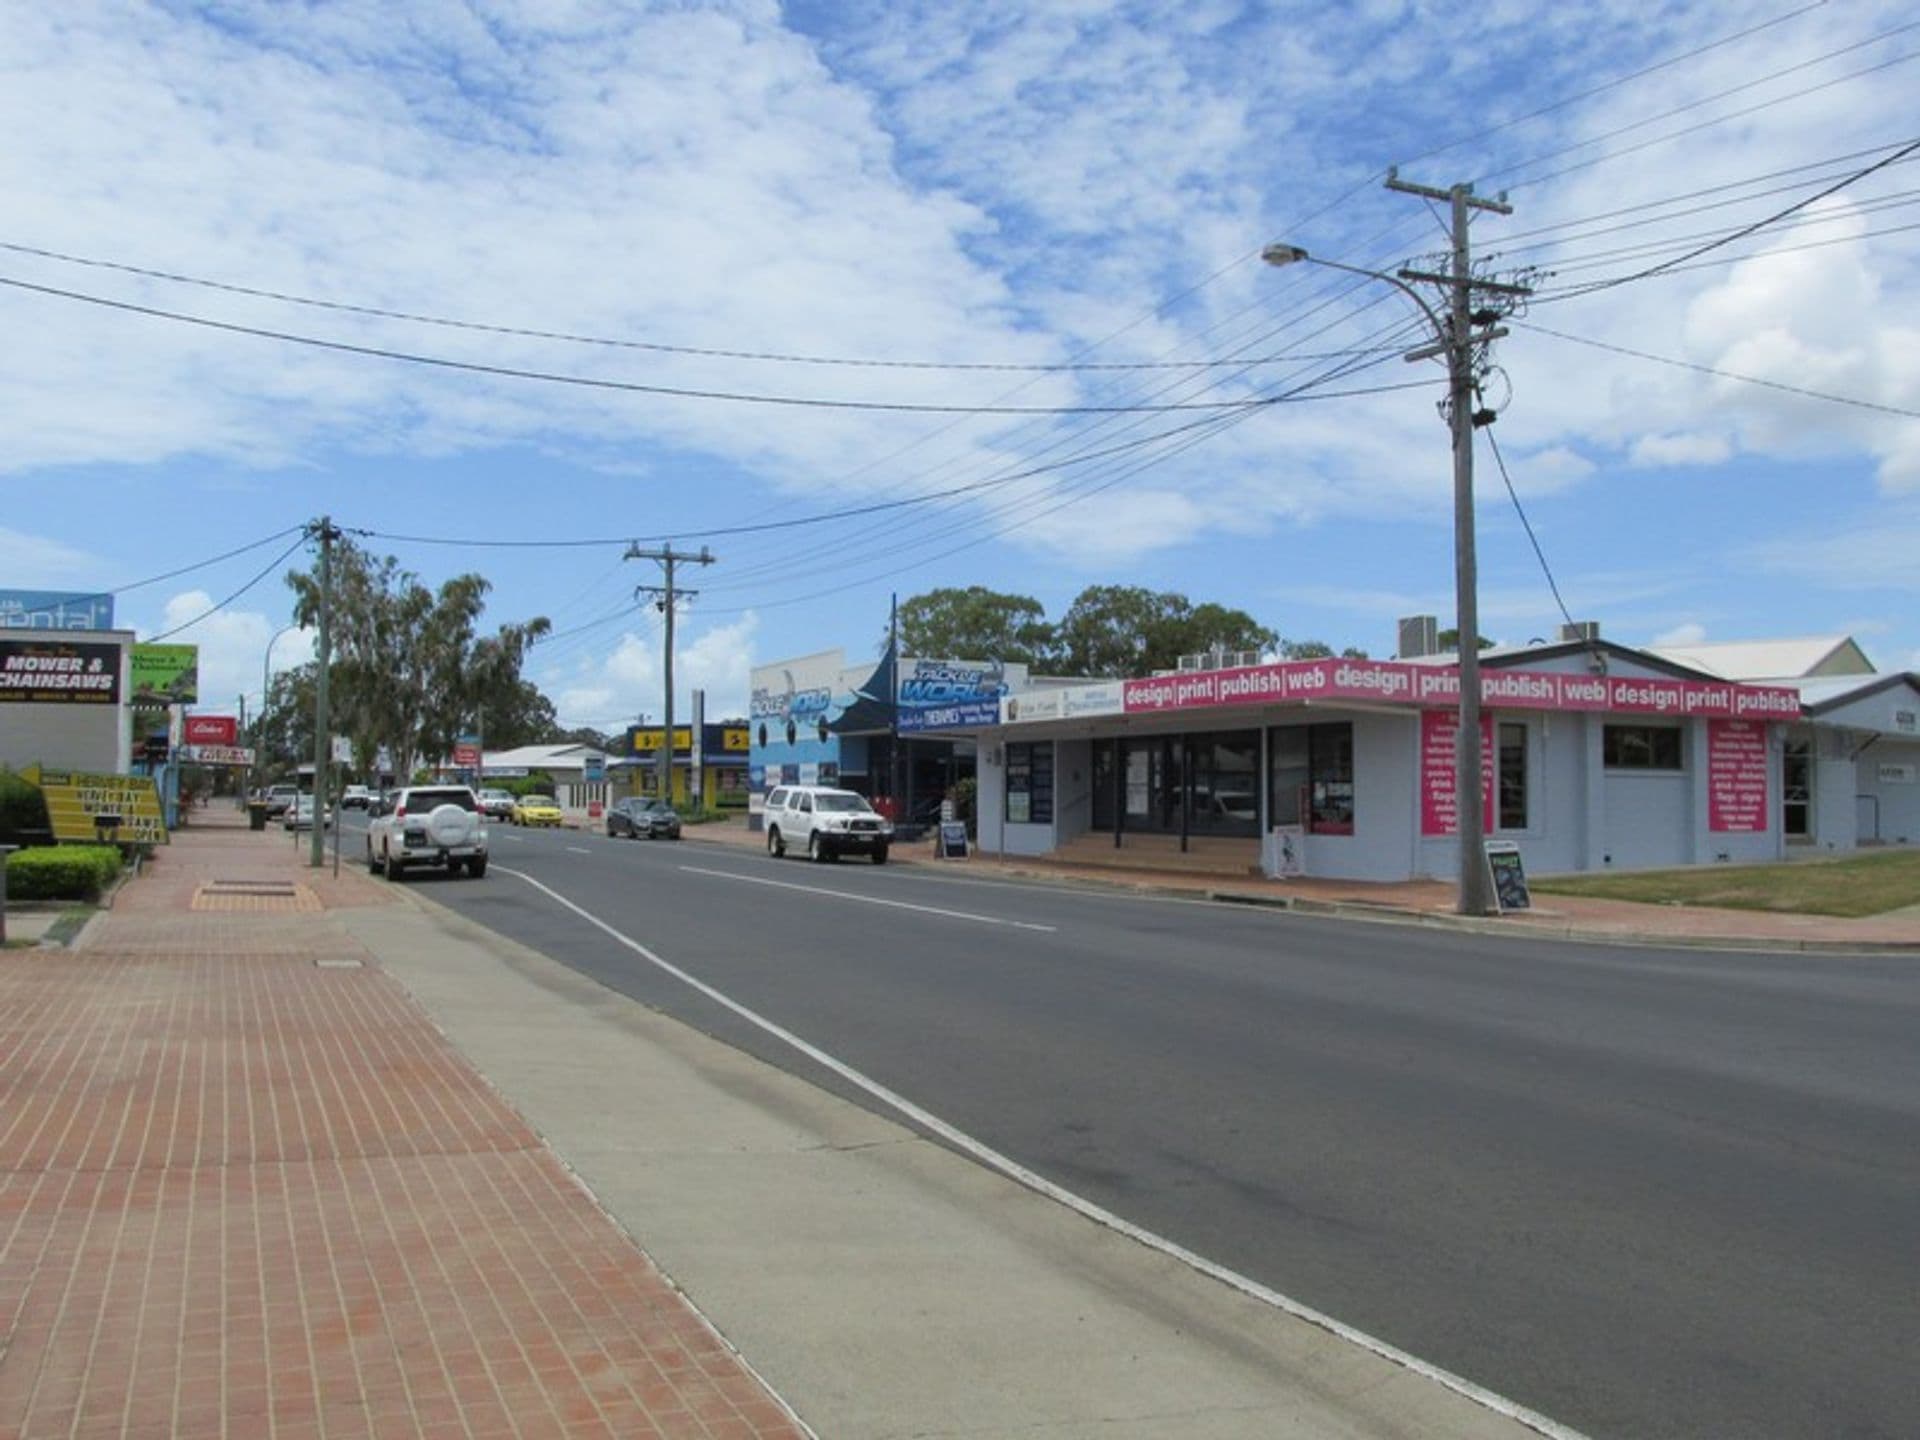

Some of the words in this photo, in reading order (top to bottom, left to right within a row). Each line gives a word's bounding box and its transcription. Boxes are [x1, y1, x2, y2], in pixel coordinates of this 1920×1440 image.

[5, 656, 82, 671] MOWER
[88, 658, 103, 672] &
[0, 672, 113, 689] CHAINSAWS
[1126, 682, 1171, 706] design
[1178, 678, 1213, 703] print
[1220, 671, 1280, 700] publish
[1288, 668, 1326, 690] web
[1334, 665, 1408, 695] design
[1421, 671, 1460, 697] prin
[1481, 677, 1554, 701] publish
[1564, 681, 1606, 700] web
[1615, 683, 1677, 710] design
[1686, 687, 1729, 711] print
[1737, 690, 1799, 714] publish
[134, 827, 161, 840] OPEN
